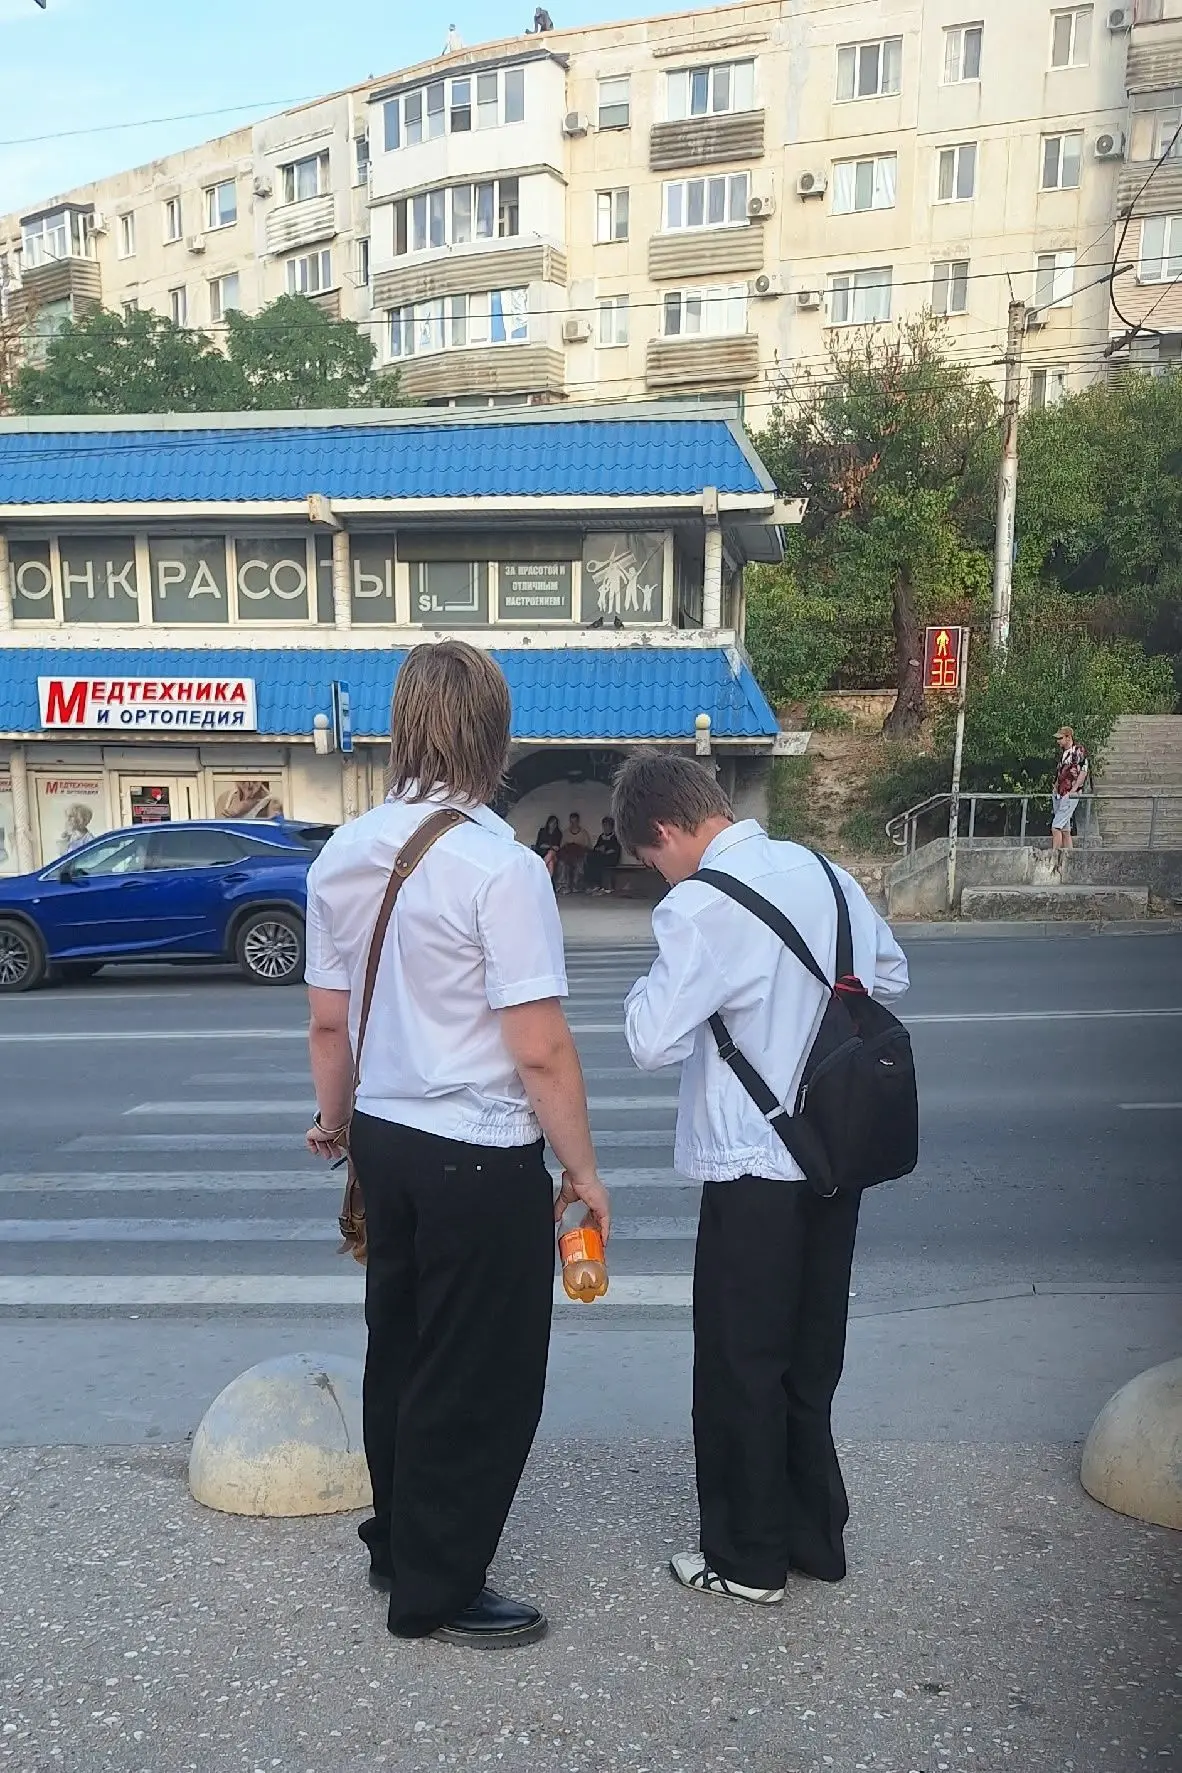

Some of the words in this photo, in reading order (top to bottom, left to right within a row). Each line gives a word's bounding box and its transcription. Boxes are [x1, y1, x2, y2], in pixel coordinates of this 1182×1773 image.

[106, 559, 393, 600] КРАСОЫ
[418, 594, 444, 612] SL
[931, 658, 955, 686] 36
[46, 681, 247, 725] МЕДТЕХНИКА
[97, 710, 109, 723] И
[120, 710, 245, 728] ОРТОПЕДИЯ
